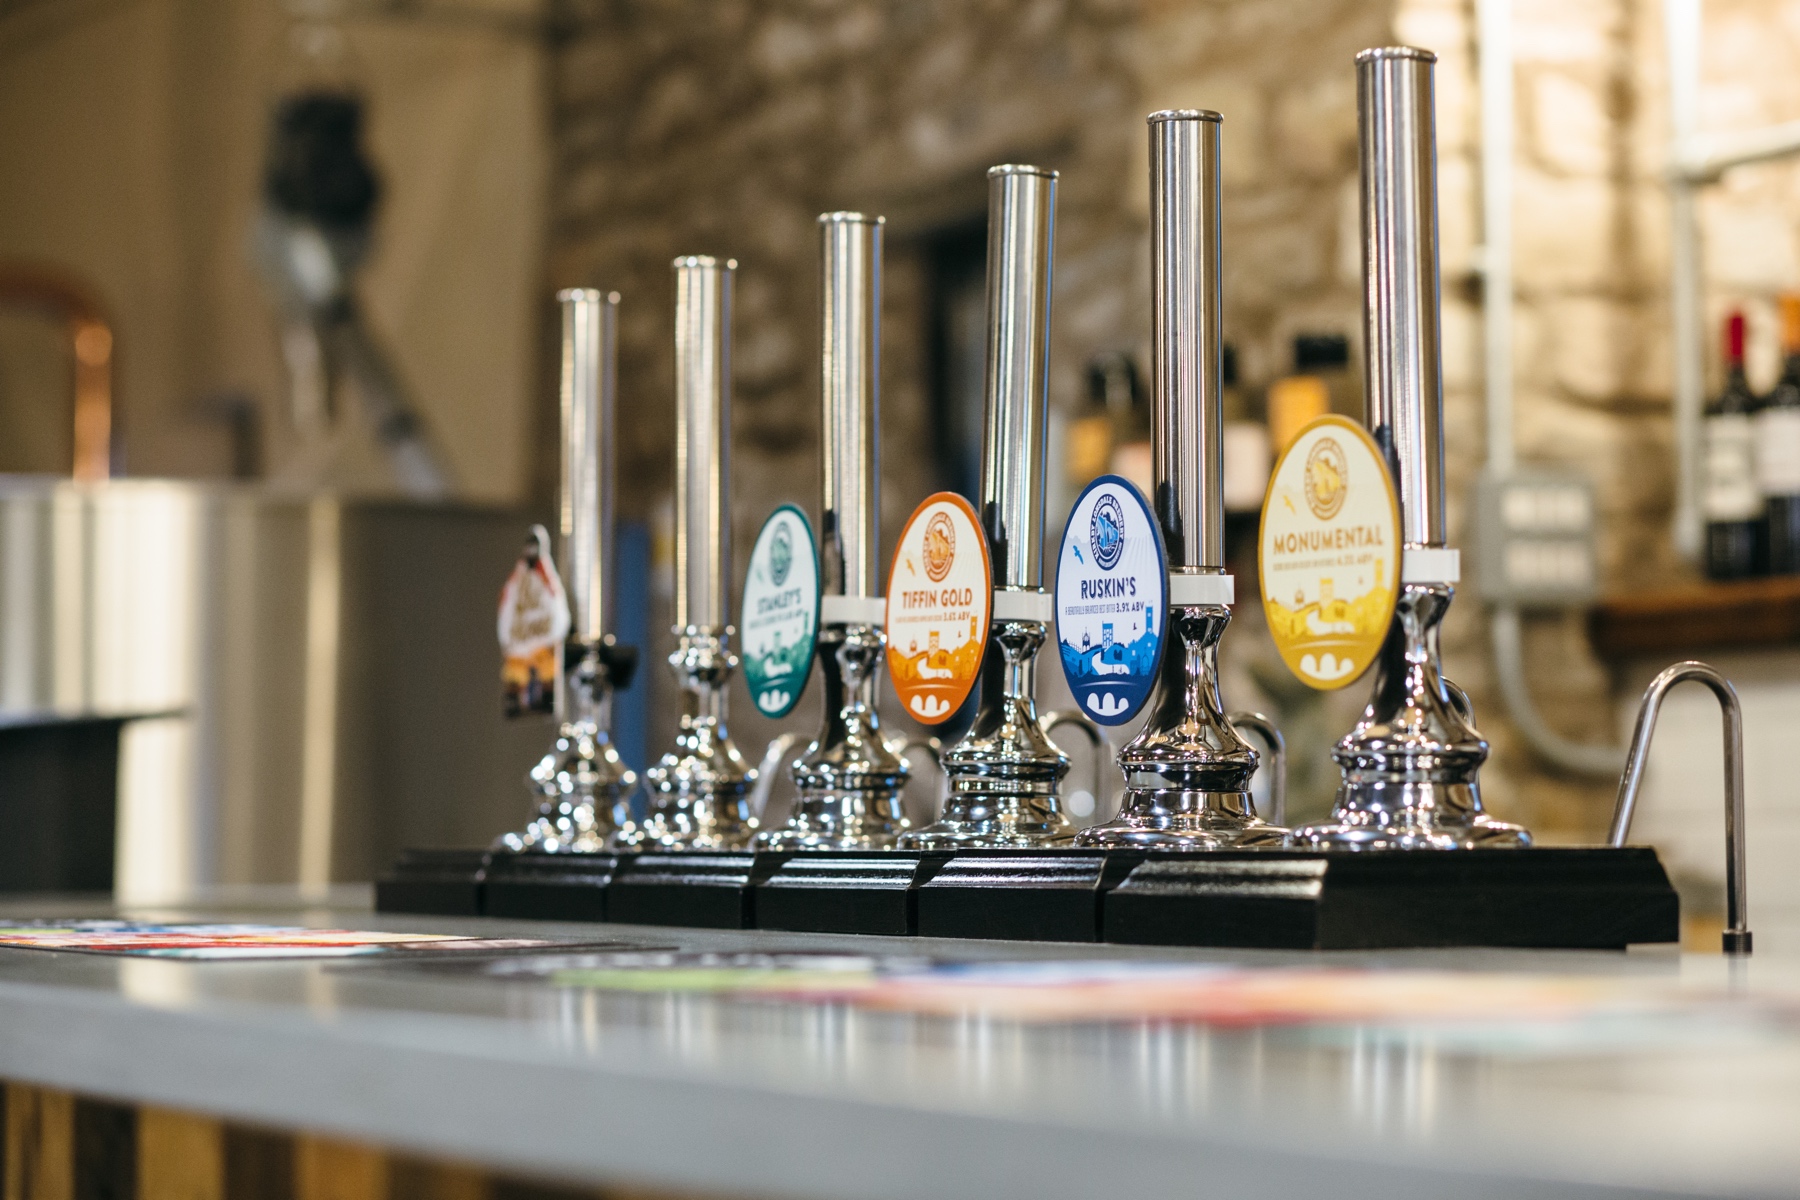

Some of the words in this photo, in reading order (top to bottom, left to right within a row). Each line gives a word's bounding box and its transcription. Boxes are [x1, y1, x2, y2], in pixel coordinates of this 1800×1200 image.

[1273, 524, 1384, 555] MONUMENTAL
[902, 589, 937, 609] TIFFIN
[941, 587, 973, 607] GOLD
[1080, 576, 1136, 600] RUSKIN'S
[958, 611, 971, 621] ABV
[1116, 602, 1130, 613] 3.9%
[1131, 601, 1144, 612] ABV
